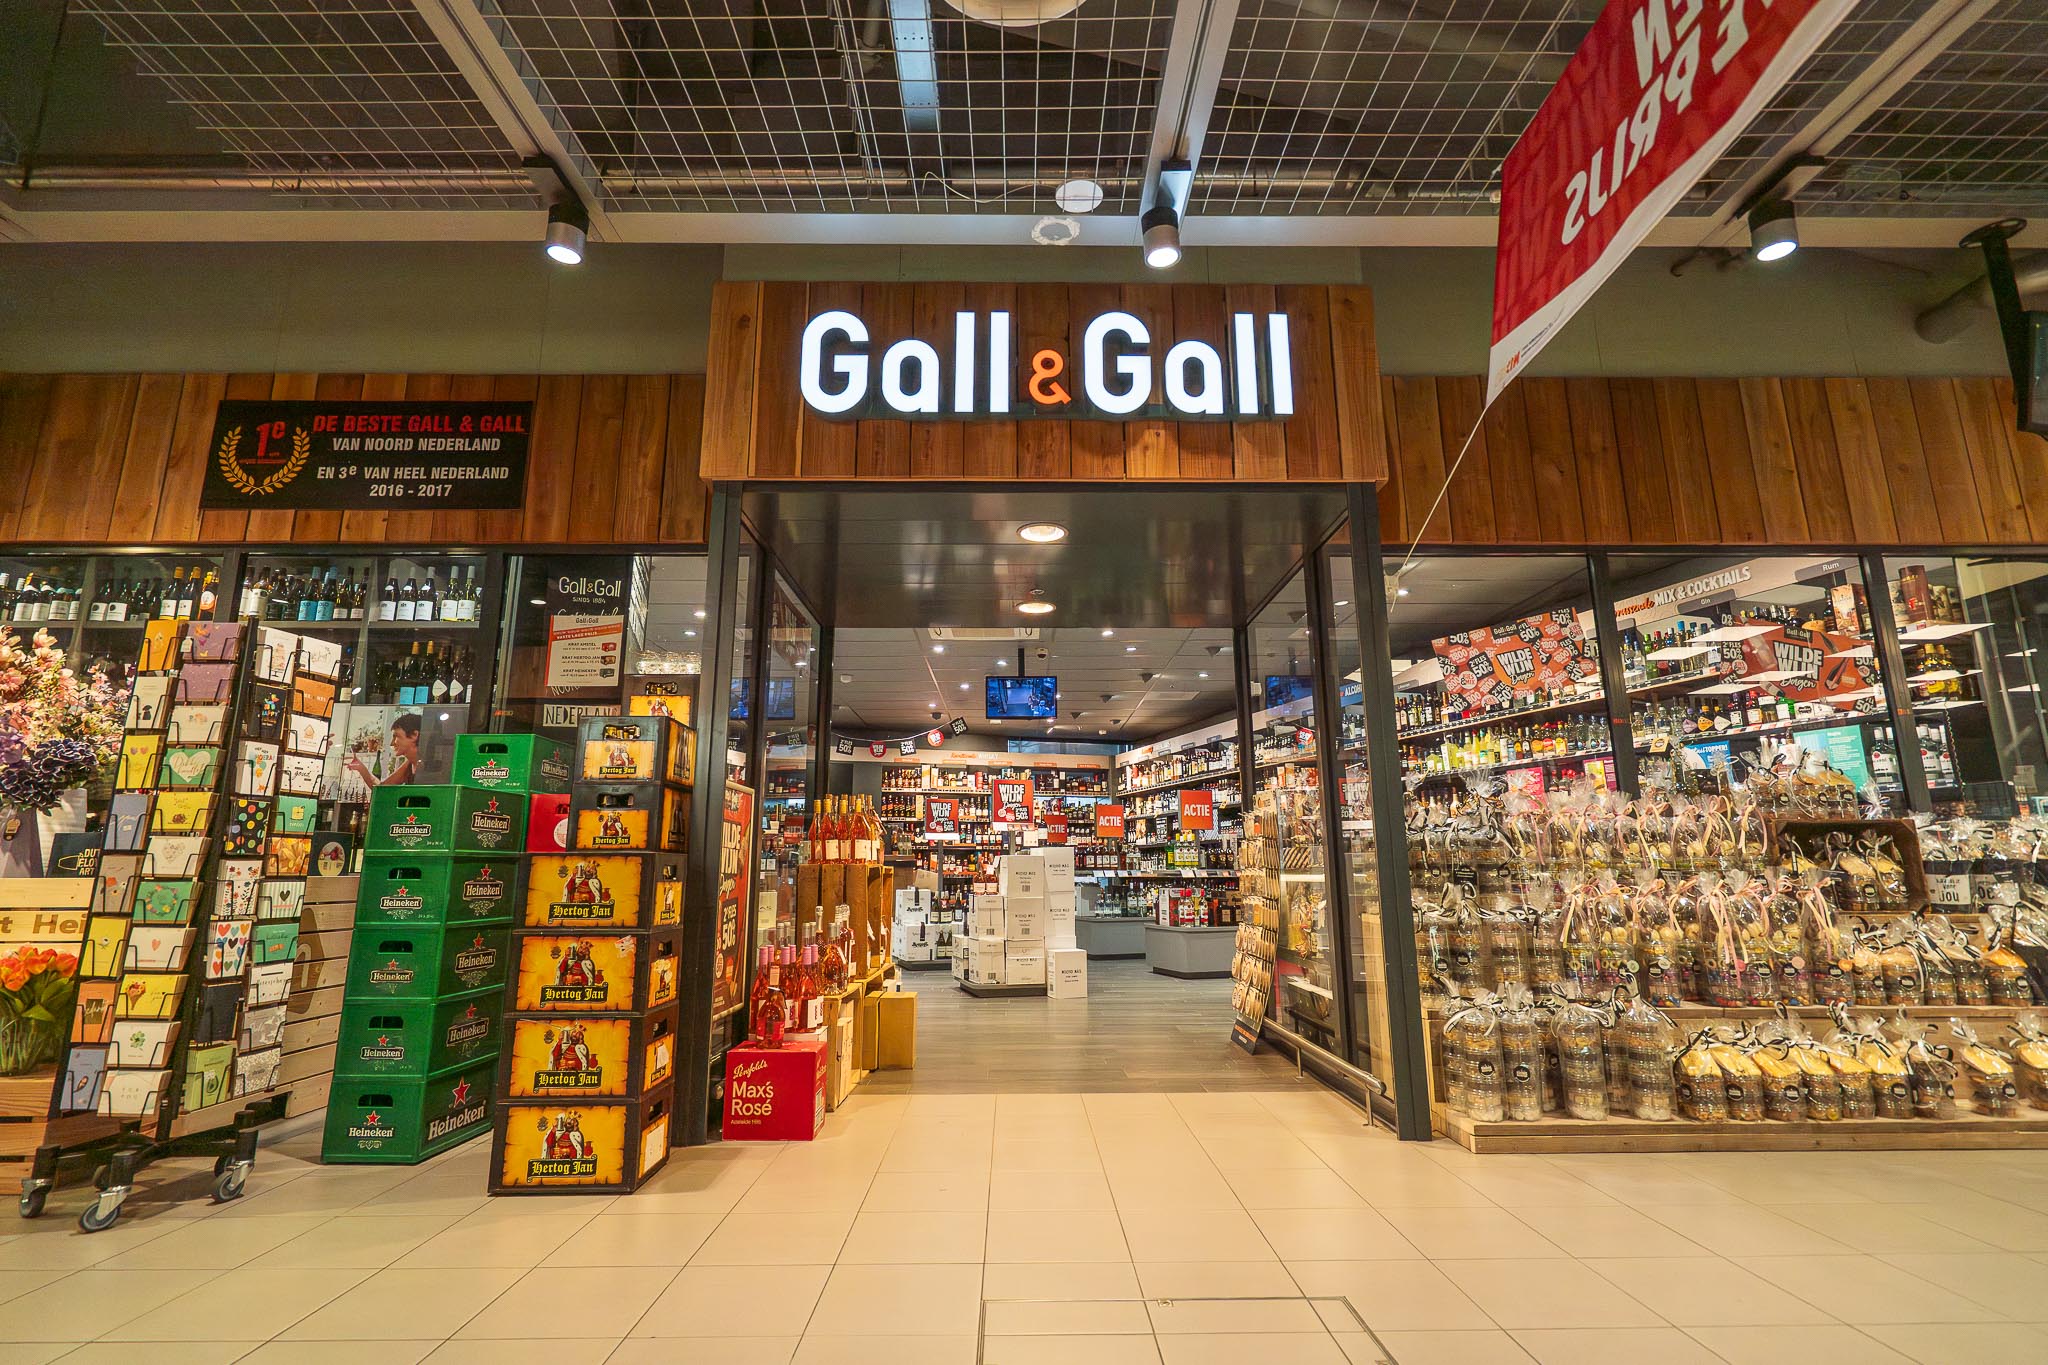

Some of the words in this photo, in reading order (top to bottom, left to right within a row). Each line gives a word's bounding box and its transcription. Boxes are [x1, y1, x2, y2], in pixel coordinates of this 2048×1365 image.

[800, 310, 1009, 413] Gall
[1028, 348, 1072, 405] &
[1083, 311, 1294, 415] Gall
[313, 415, 337, 432] DE
[343, 415, 401, 432] BESTE
[407, 415, 452, 432] GALL
[458, 415, 473, 432] &
[480, 415, 525, 433] GALL
[332, 438, 361, 451] VAN
[364, 438, 413, 451] NOORD
[418, 438, 501, 451] NEDERLAND
[317, 467, 334, 479] EN
[338, 463, 357, 479] 3e
[364, 467, 391, 479] VAN
[393, 467, 427, 480] HEEL
[430, 467, 509, 480] NEDERLAND
[369, 484, 403, 497] 2016
[417, 484, 452, 497] 2017
[1822, 561, 1840, 572] Rum
[1654, 591, 1676, 607] MIX
[1677, 586, 1686, 600] &
[1686, 566, 1751, 597] COCKTAILS
[1496, 648, 1533, 665] WILDE
[1723, 648, 1743, 660] 50%
[1774, 642, 1823, 665] WILDE
[1472, 660, 1493, 678] 50%
[1501, 659, 1535, 676] WIJN
[1778, 658, 1819, 681] WIJN
[901, 745, 915, 754] 50%
[474, 769, 507, 777] Heineken
[601, 766, 623, 775] Hertog
[623, 766, 635, 774] Jan
[998, 784, 1025, 795] WILDE
[1000, 792, 1023, 803] WIJN
[930, 802, 951, 811] WILDE
[932, 809, 950, 817] WIJN
[1183, 804, 1211, 817] ACTIE
[474, 815, 508, 829] Heineken
[1099, 815, 1122, 827] ACTIE
[392, 826, 429, 834] Heineken
[595, 836, 616, 845] Hertog
[616, 836, 629, 844] Jan
[466, 884, 500, 896] Heineken
[383, 899, 420, 907] Heineken
[552, 904, 589, 918] Hertog
[591, 905, 611, 917] Jan
[459, 955, 493, 969] Heineken
[373, 972, 410, 981] Heineken
[545, 988, 582, 1001] Hertog
[584, 988, 604, 1000] Jan
[450, 1022, 487, 1041] Heineken
[364, 1049, 402, 1057] Heineken
[732, 1059, 768, 1080] Penfolds
[538, 1073, 575, 1086] Hertog
[577, 1073, 598, 1086] Jan
[732, 1080, 774, 1099] Max's
[731, 1098, 773, 1116] Rosé
[428, 1100, 487, 1141] Heineken
[349, 1127, 394, 1138] Heineken
[532, 1161, 570, 1176] Hertog
[572, 1161, 593, 1175] Jan
